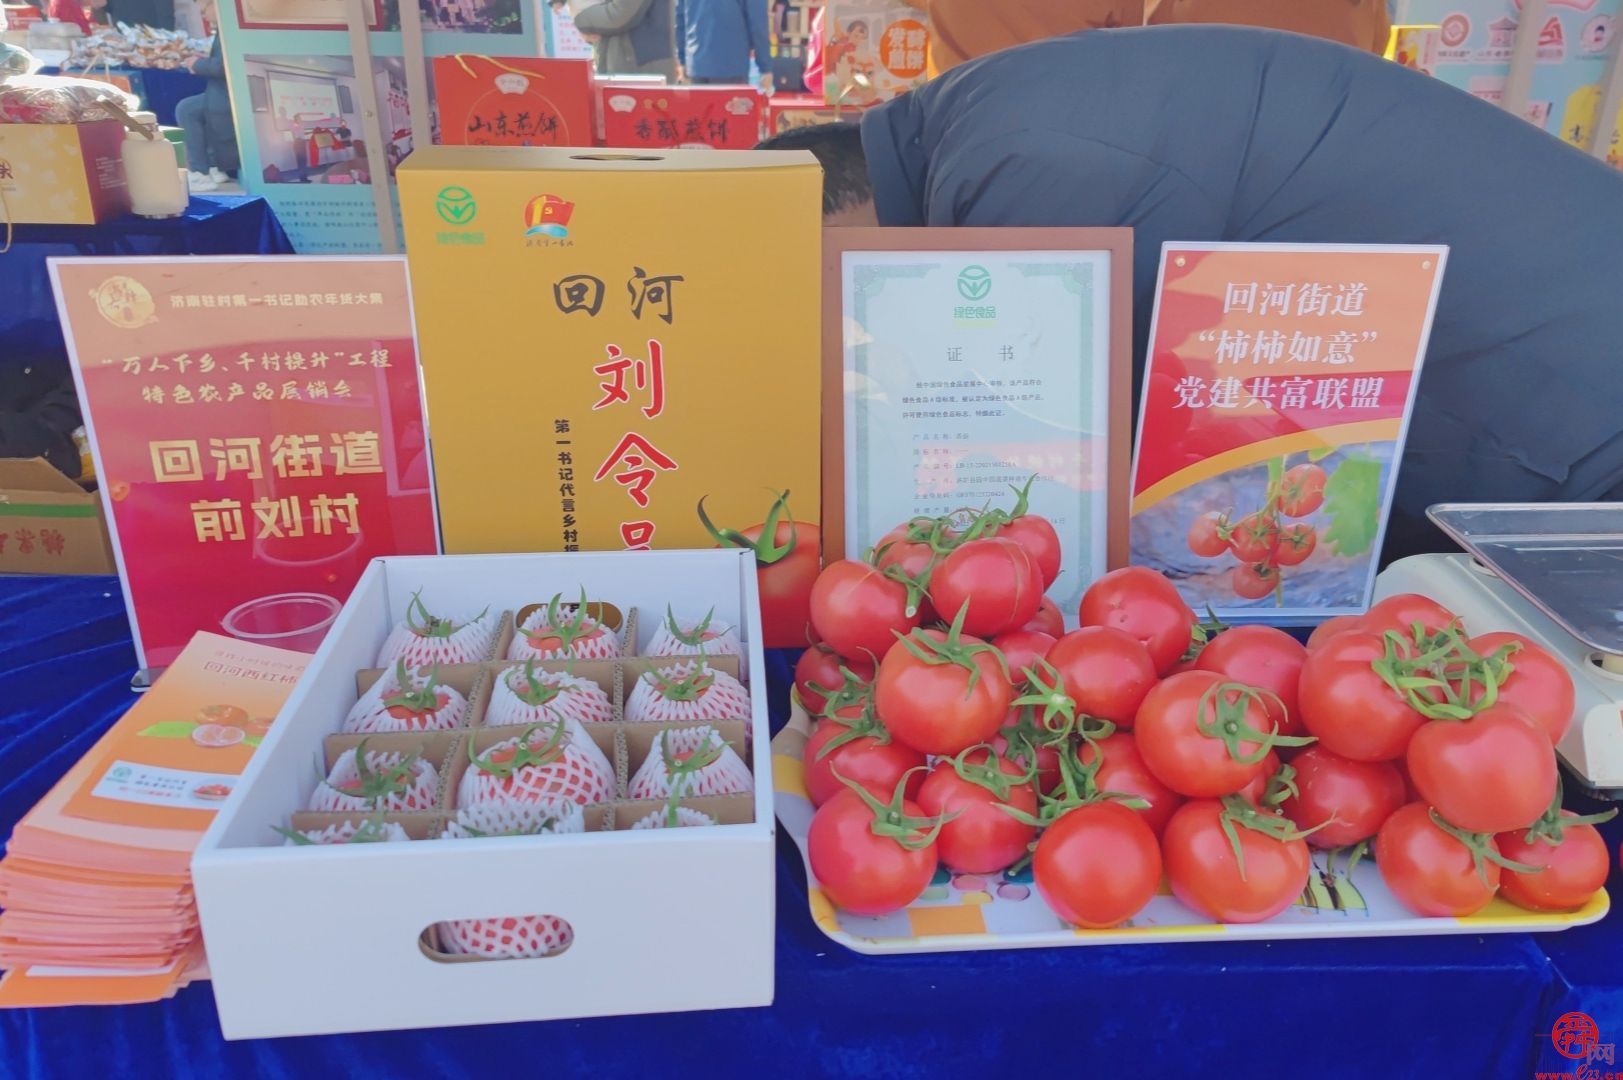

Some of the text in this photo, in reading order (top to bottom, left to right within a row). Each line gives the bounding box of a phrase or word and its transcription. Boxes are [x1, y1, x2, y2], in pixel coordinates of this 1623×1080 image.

[468, 111, 560, 141] 山东煎饼
[552, 266, 685, 325] 回河
[953, 305, 997, 319] 绿色食品
[1222, 281, 1369, 317] 回河街道
[142, 379, 354, 406] 特色农产品展销会
[1171, 375, 1385, 410] 党建共富联盟
[148, 430, 384, 484] 回河街道
[190, 492, 360, 543] 前刘村
